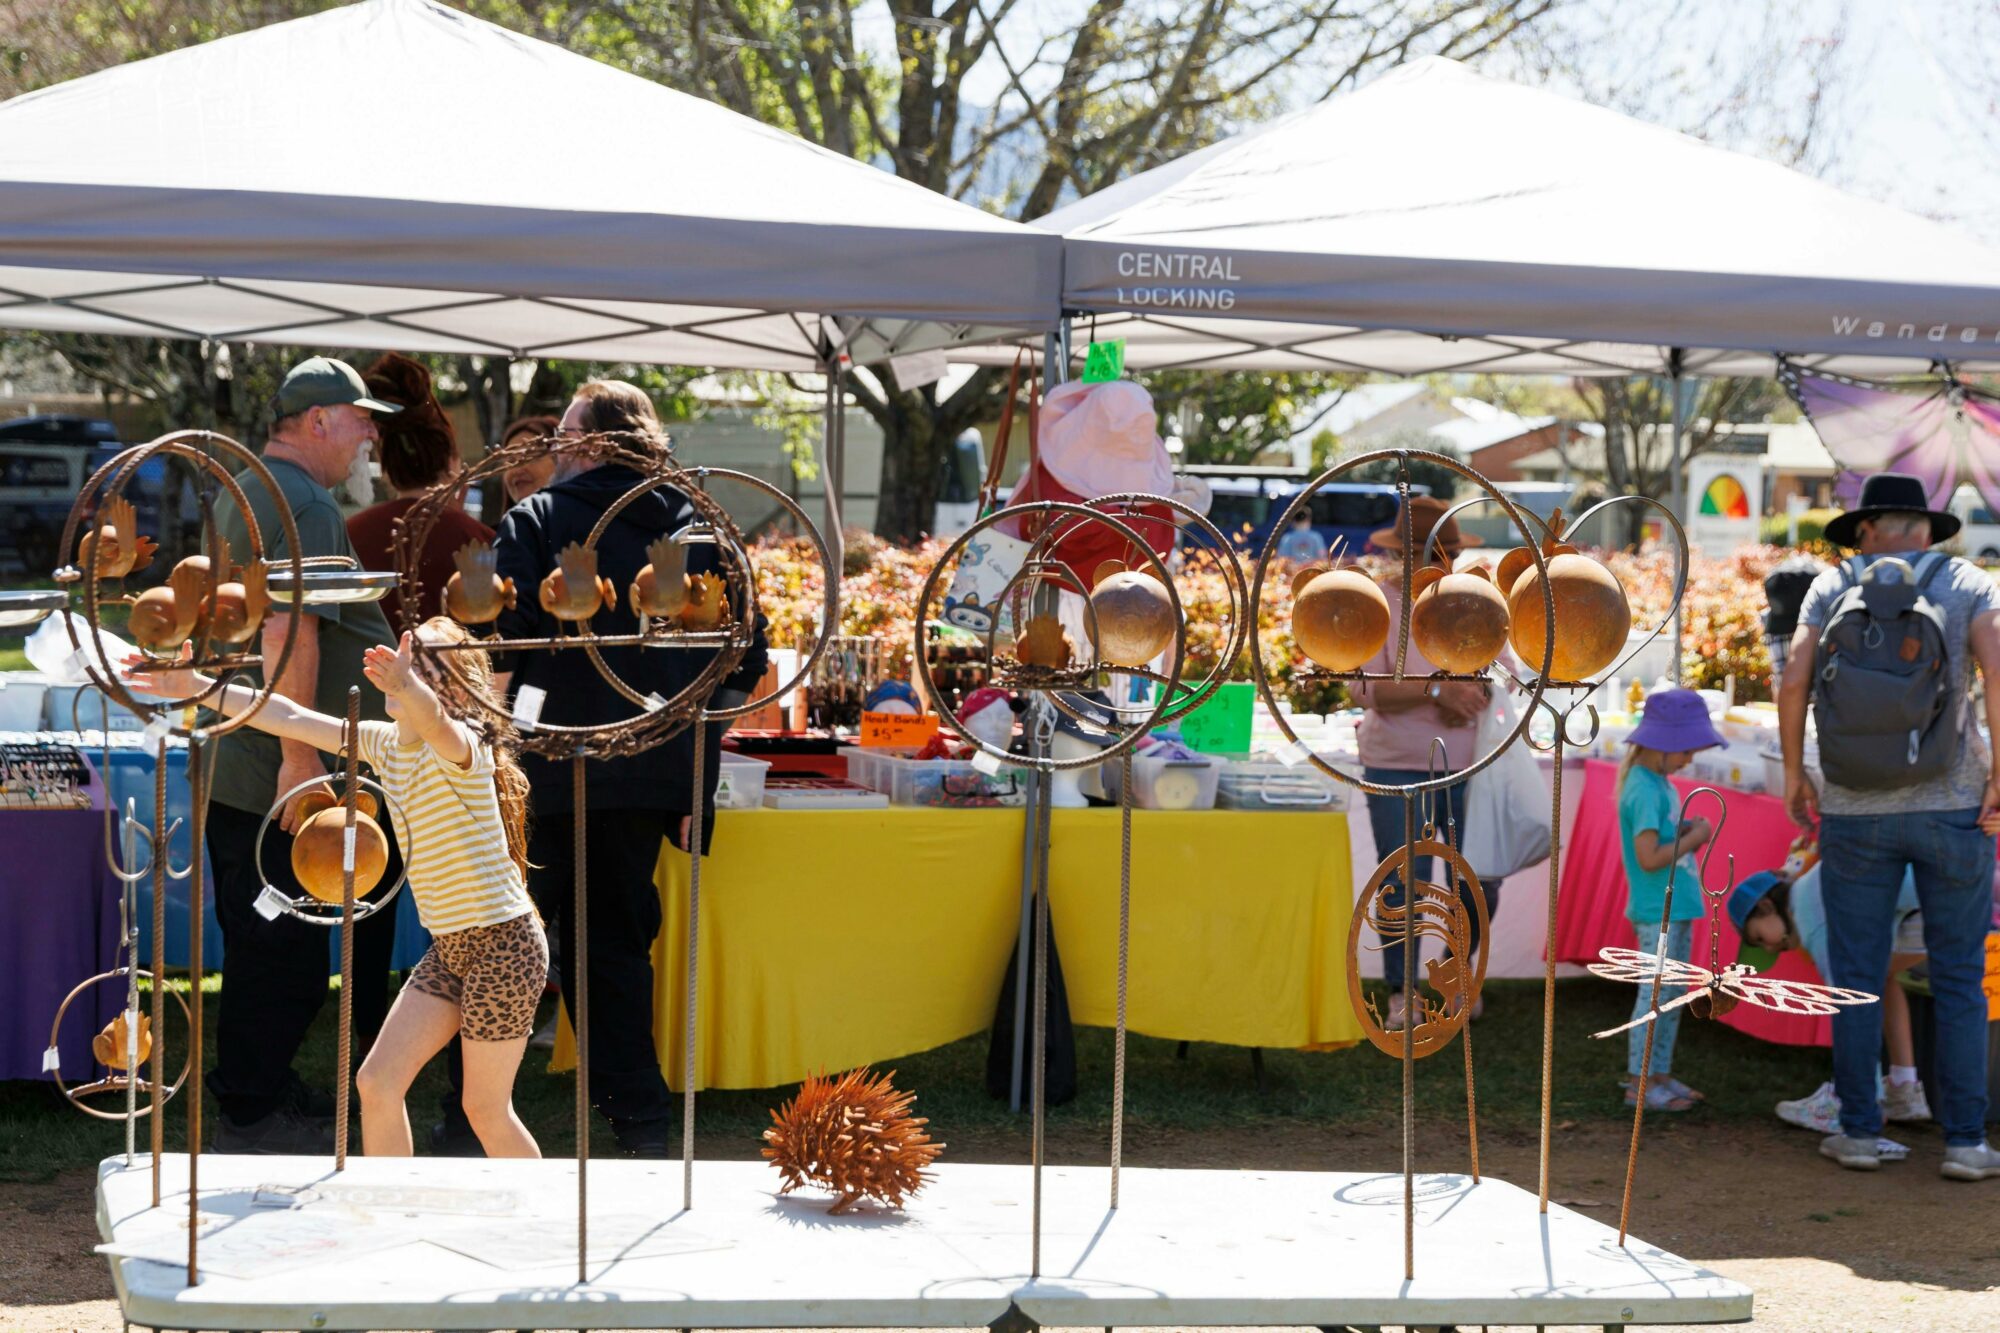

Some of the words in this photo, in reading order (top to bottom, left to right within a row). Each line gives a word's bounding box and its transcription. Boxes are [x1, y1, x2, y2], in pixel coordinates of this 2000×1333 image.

[1117, 252, 1241, 281] CENTRAL
[1116, 287, 1236, 310] LOCKING
[864, 714, 889, 724] Head
